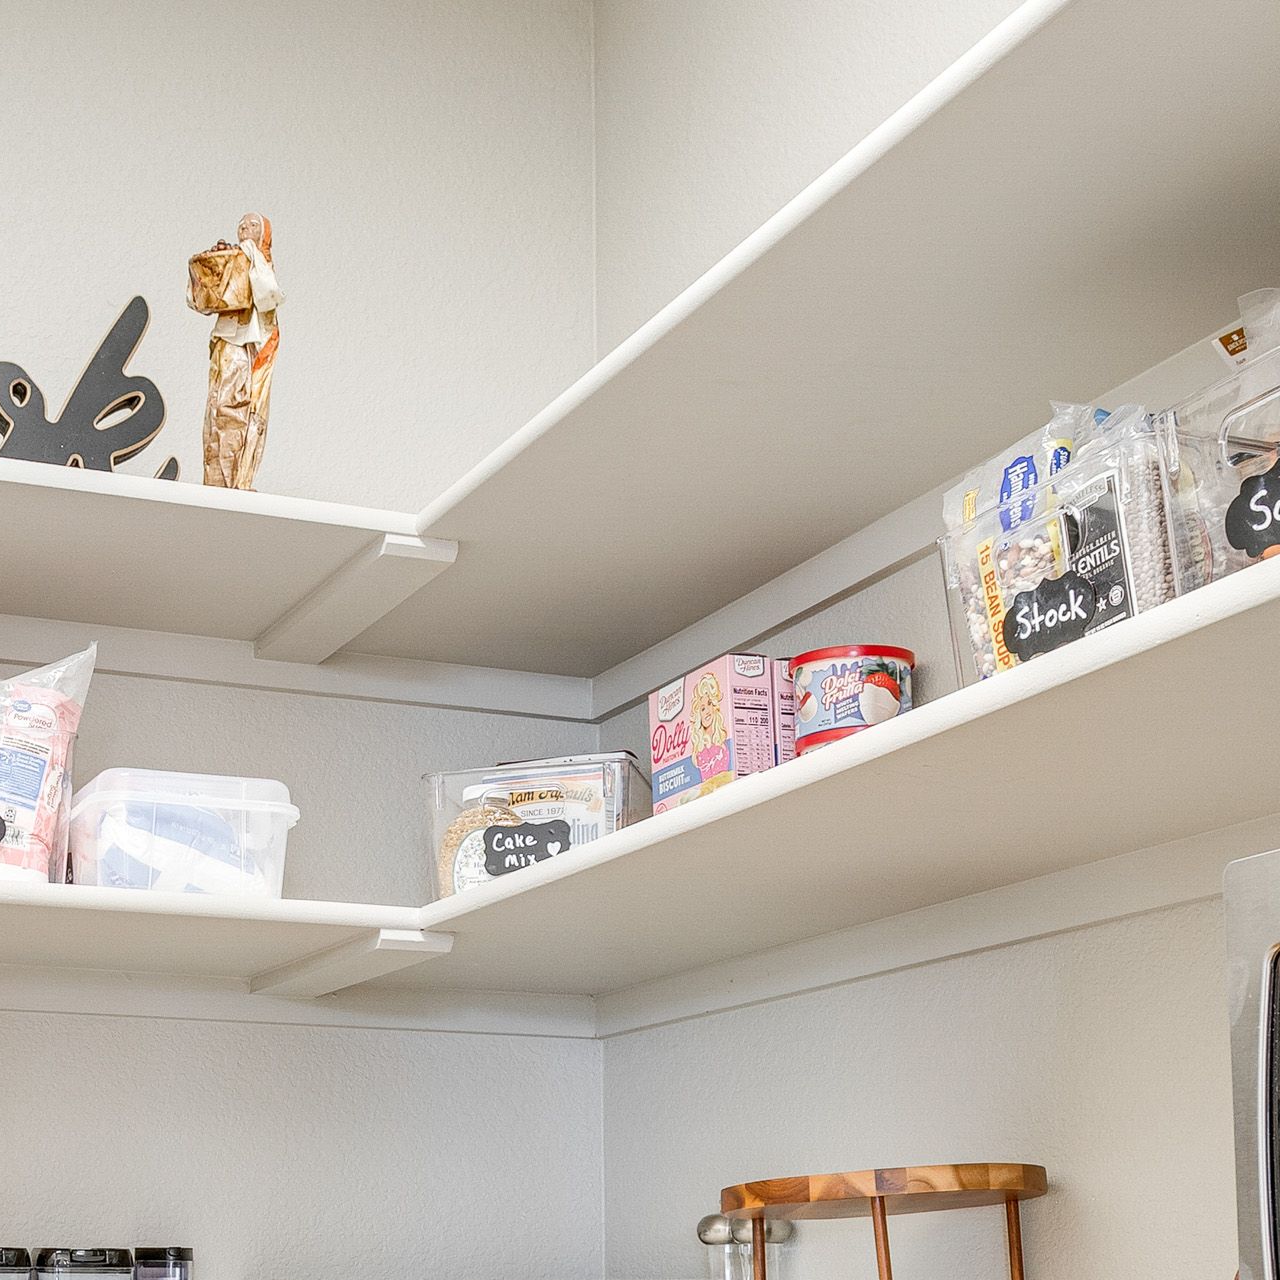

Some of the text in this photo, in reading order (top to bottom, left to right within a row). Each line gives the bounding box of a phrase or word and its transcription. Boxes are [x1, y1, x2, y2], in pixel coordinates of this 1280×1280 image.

[979, 545, 1011, 666] 15 BEAN SOUP
[1015, 590, 1087, 640] Stock
[736, 657, 762, 668] Duncan
[822, 671, 861, 692] Dolci
[733, 687, 768, 697] Nutrition Facts
[651, 720, 691, 764] Dolly
[659, 774, 685, 795] BISCUIT
[521, 809, 544, 817] SINCE
[492, 832, 538, 852] Cake
[504, 853, 538, 869] Mix
